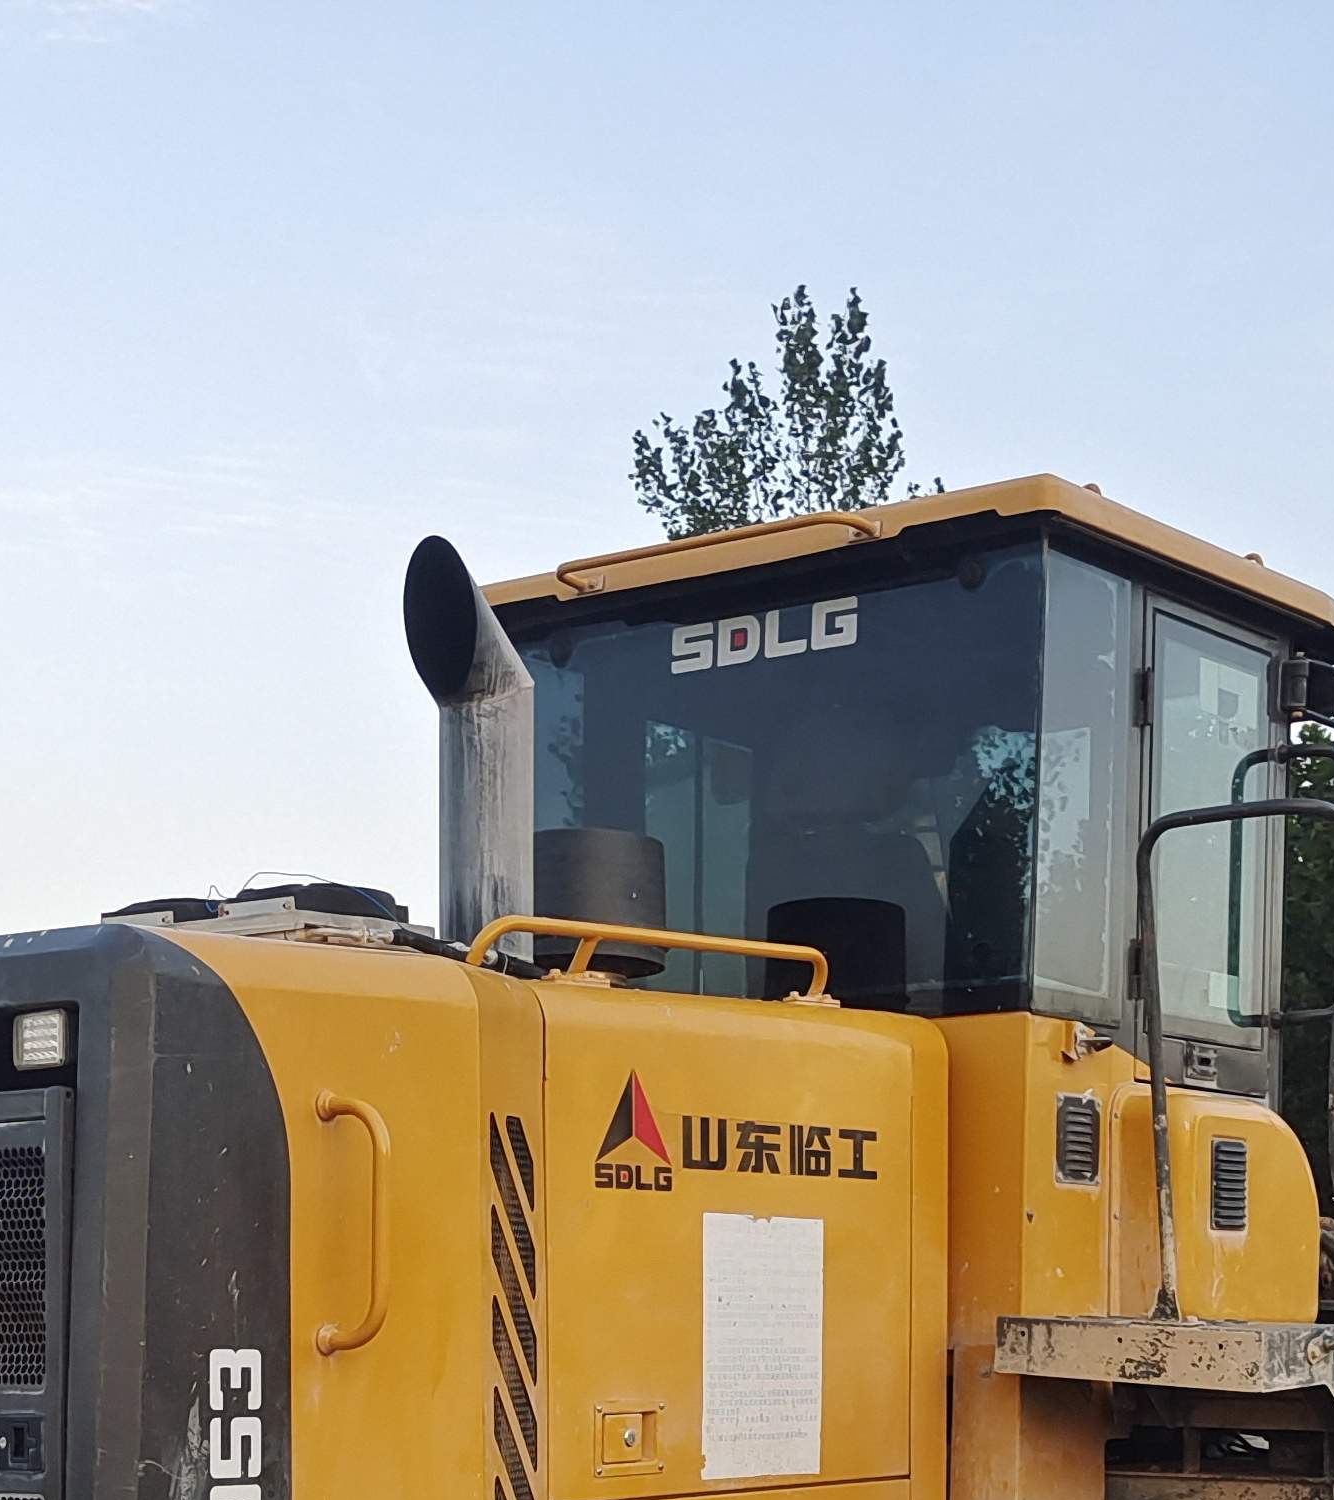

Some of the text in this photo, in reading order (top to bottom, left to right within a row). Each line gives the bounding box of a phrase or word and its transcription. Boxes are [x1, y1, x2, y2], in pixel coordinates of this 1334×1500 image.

[671, 595, 858, 674] SDLG
[594, 1163, 673, 1192] SDLG
[682, 1115, 878, 1181] 山东临工
